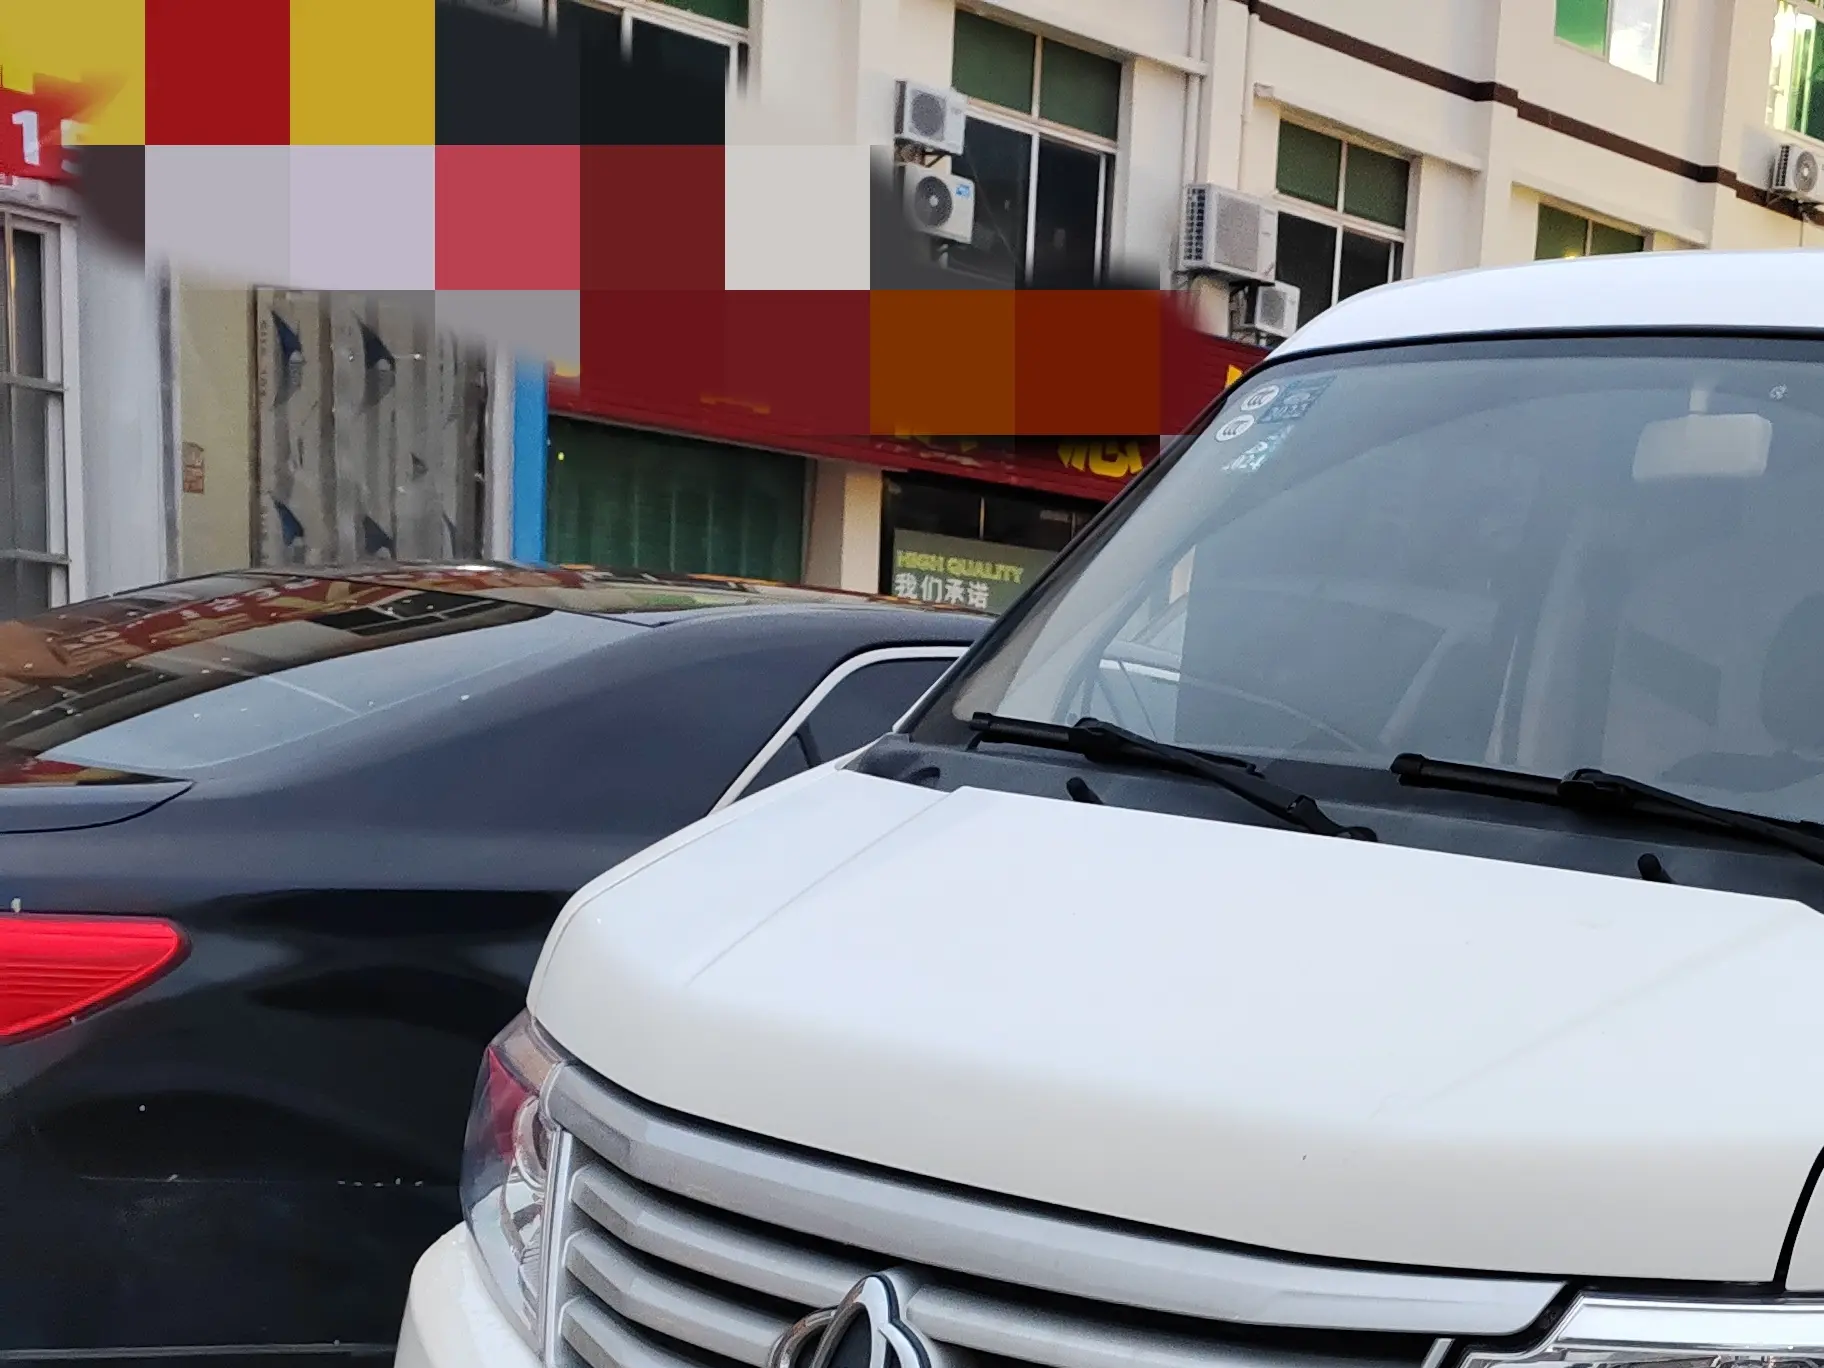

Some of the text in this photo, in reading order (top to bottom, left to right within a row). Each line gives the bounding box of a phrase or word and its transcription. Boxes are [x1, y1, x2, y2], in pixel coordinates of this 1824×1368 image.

[947, 556, 1024, 584] QUALITY
[894, 572, 990, 609] 我们承诺
